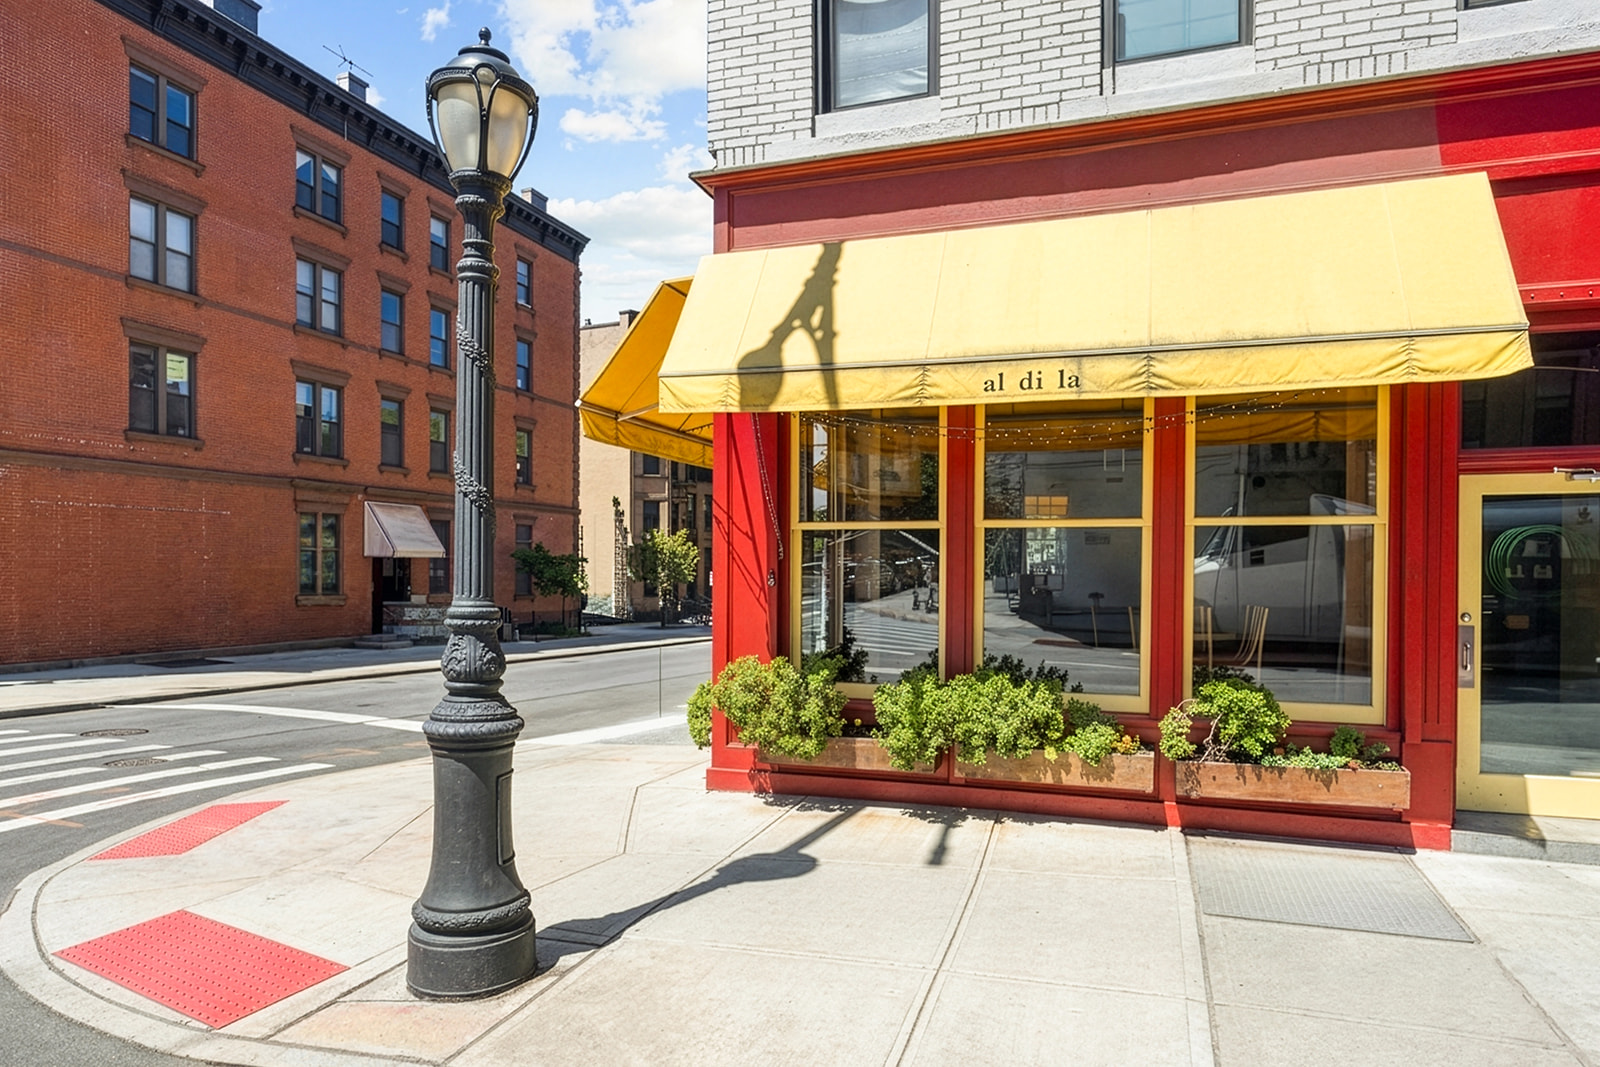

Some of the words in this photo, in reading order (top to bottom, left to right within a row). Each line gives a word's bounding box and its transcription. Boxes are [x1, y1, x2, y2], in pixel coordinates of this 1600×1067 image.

[983, 372, 1005, 393] al
[1019, 370, 1043, 391] di
[1058, 369, 1081, 389] la
